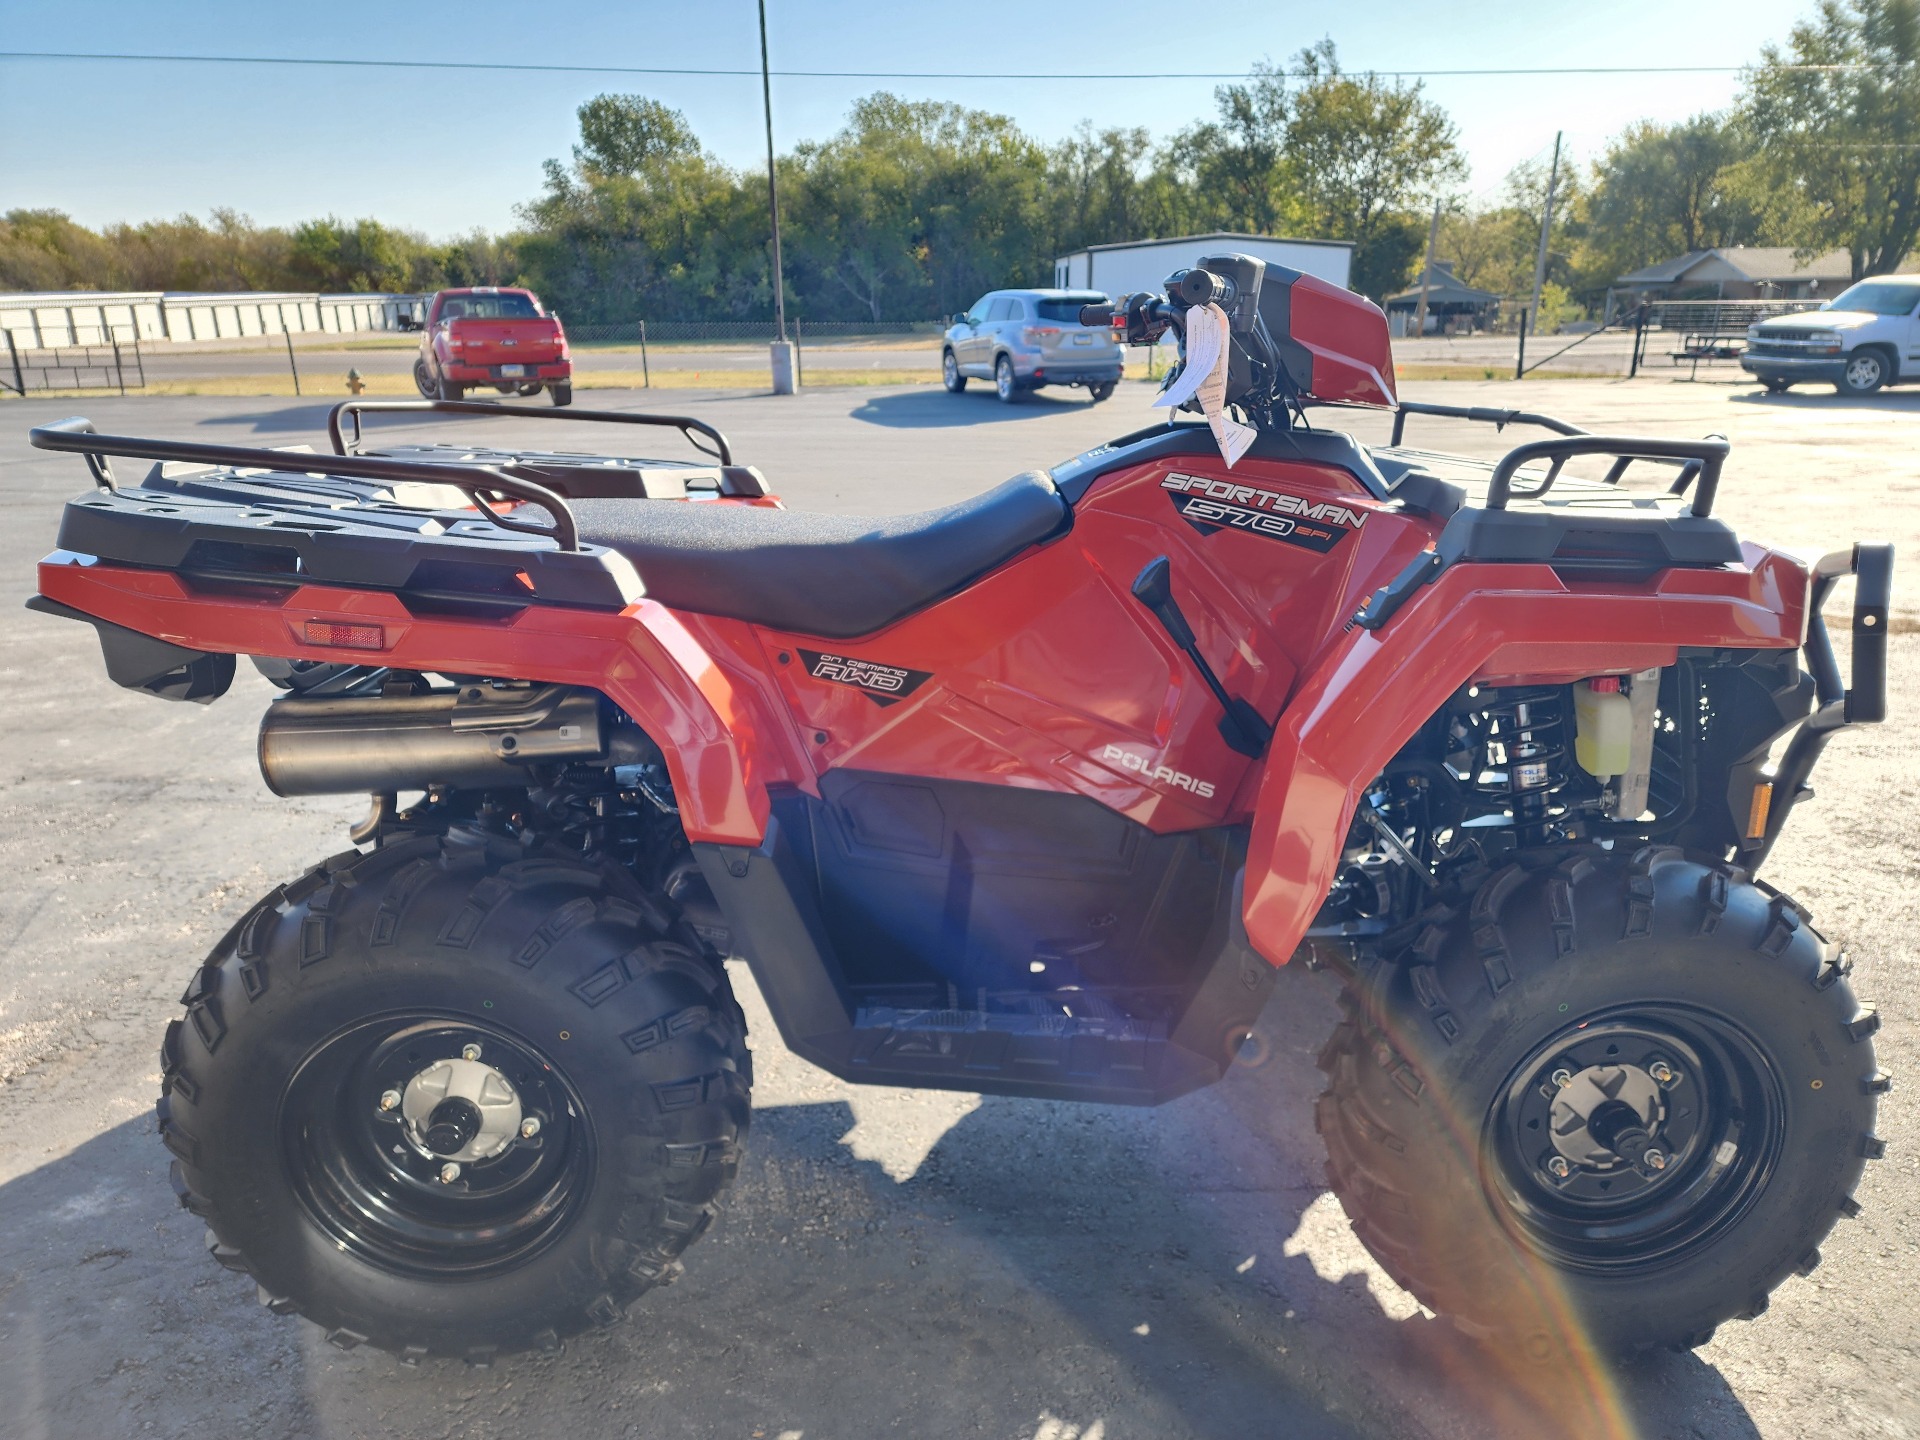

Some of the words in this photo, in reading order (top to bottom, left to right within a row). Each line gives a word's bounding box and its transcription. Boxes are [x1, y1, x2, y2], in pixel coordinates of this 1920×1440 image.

[1160, 471, 1371, 529] SPORTSMAN
[1182, 497, 1295, 537] 570
[1295, 525, 1332, 541] EFI
[812, 661, 904, 692] AWD
[820, 654, 842, 664] ON
[847, 660, 909, 678] DEMAND
[1102, 744, 1216, 799] POLARIS
